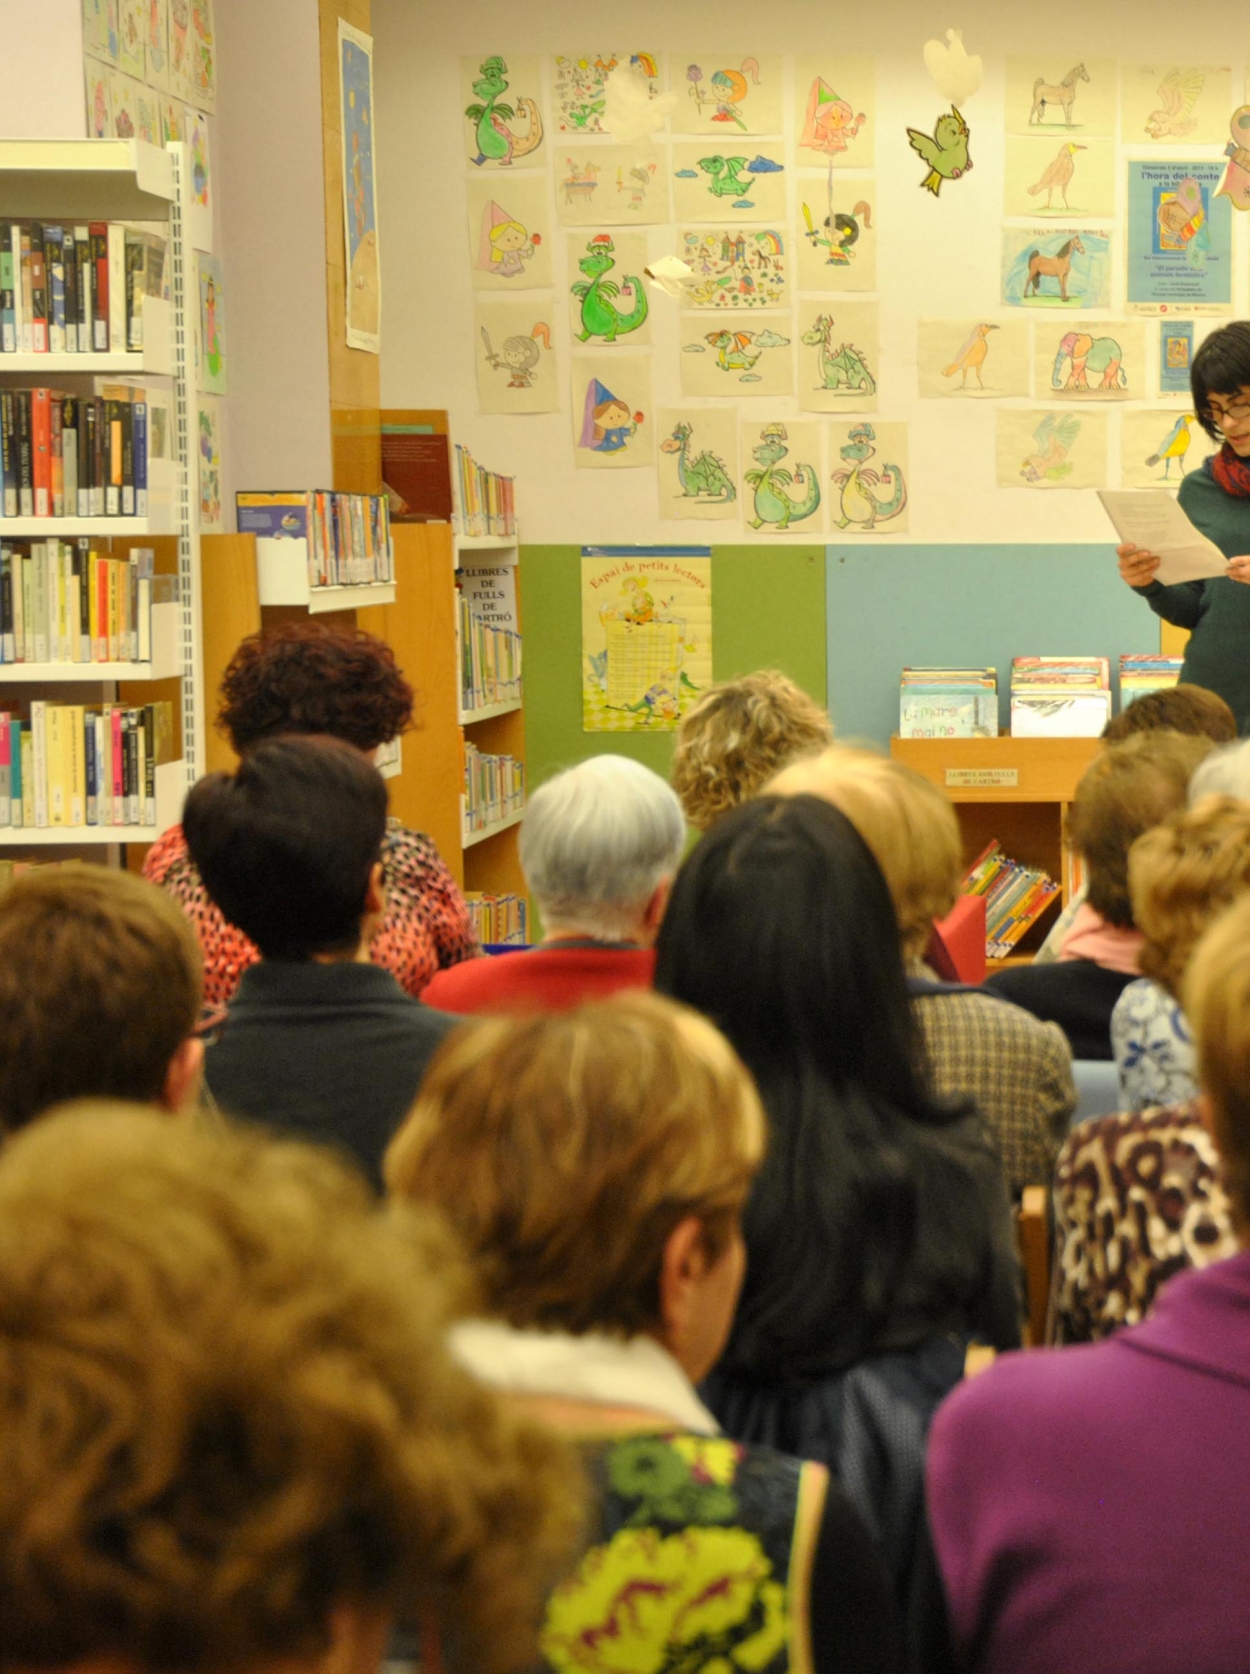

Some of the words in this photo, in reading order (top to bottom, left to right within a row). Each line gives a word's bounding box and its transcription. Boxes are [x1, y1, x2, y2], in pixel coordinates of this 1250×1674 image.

[1141, 172, 1170, 180] l'hora
[465, 567, 509, 577] LLIBRES
[589, 568, 620, 589] Espai
[622, 562, 635, 573] de
[638, 561, 669, 573] petits
[673, 563, 707, 589] lectors
[481, 579, 496, 588] DE
[473, 591, 505, 600] FULLS
[482, 603, 497, 611] DE
[921, 706, 958, 719] mare
